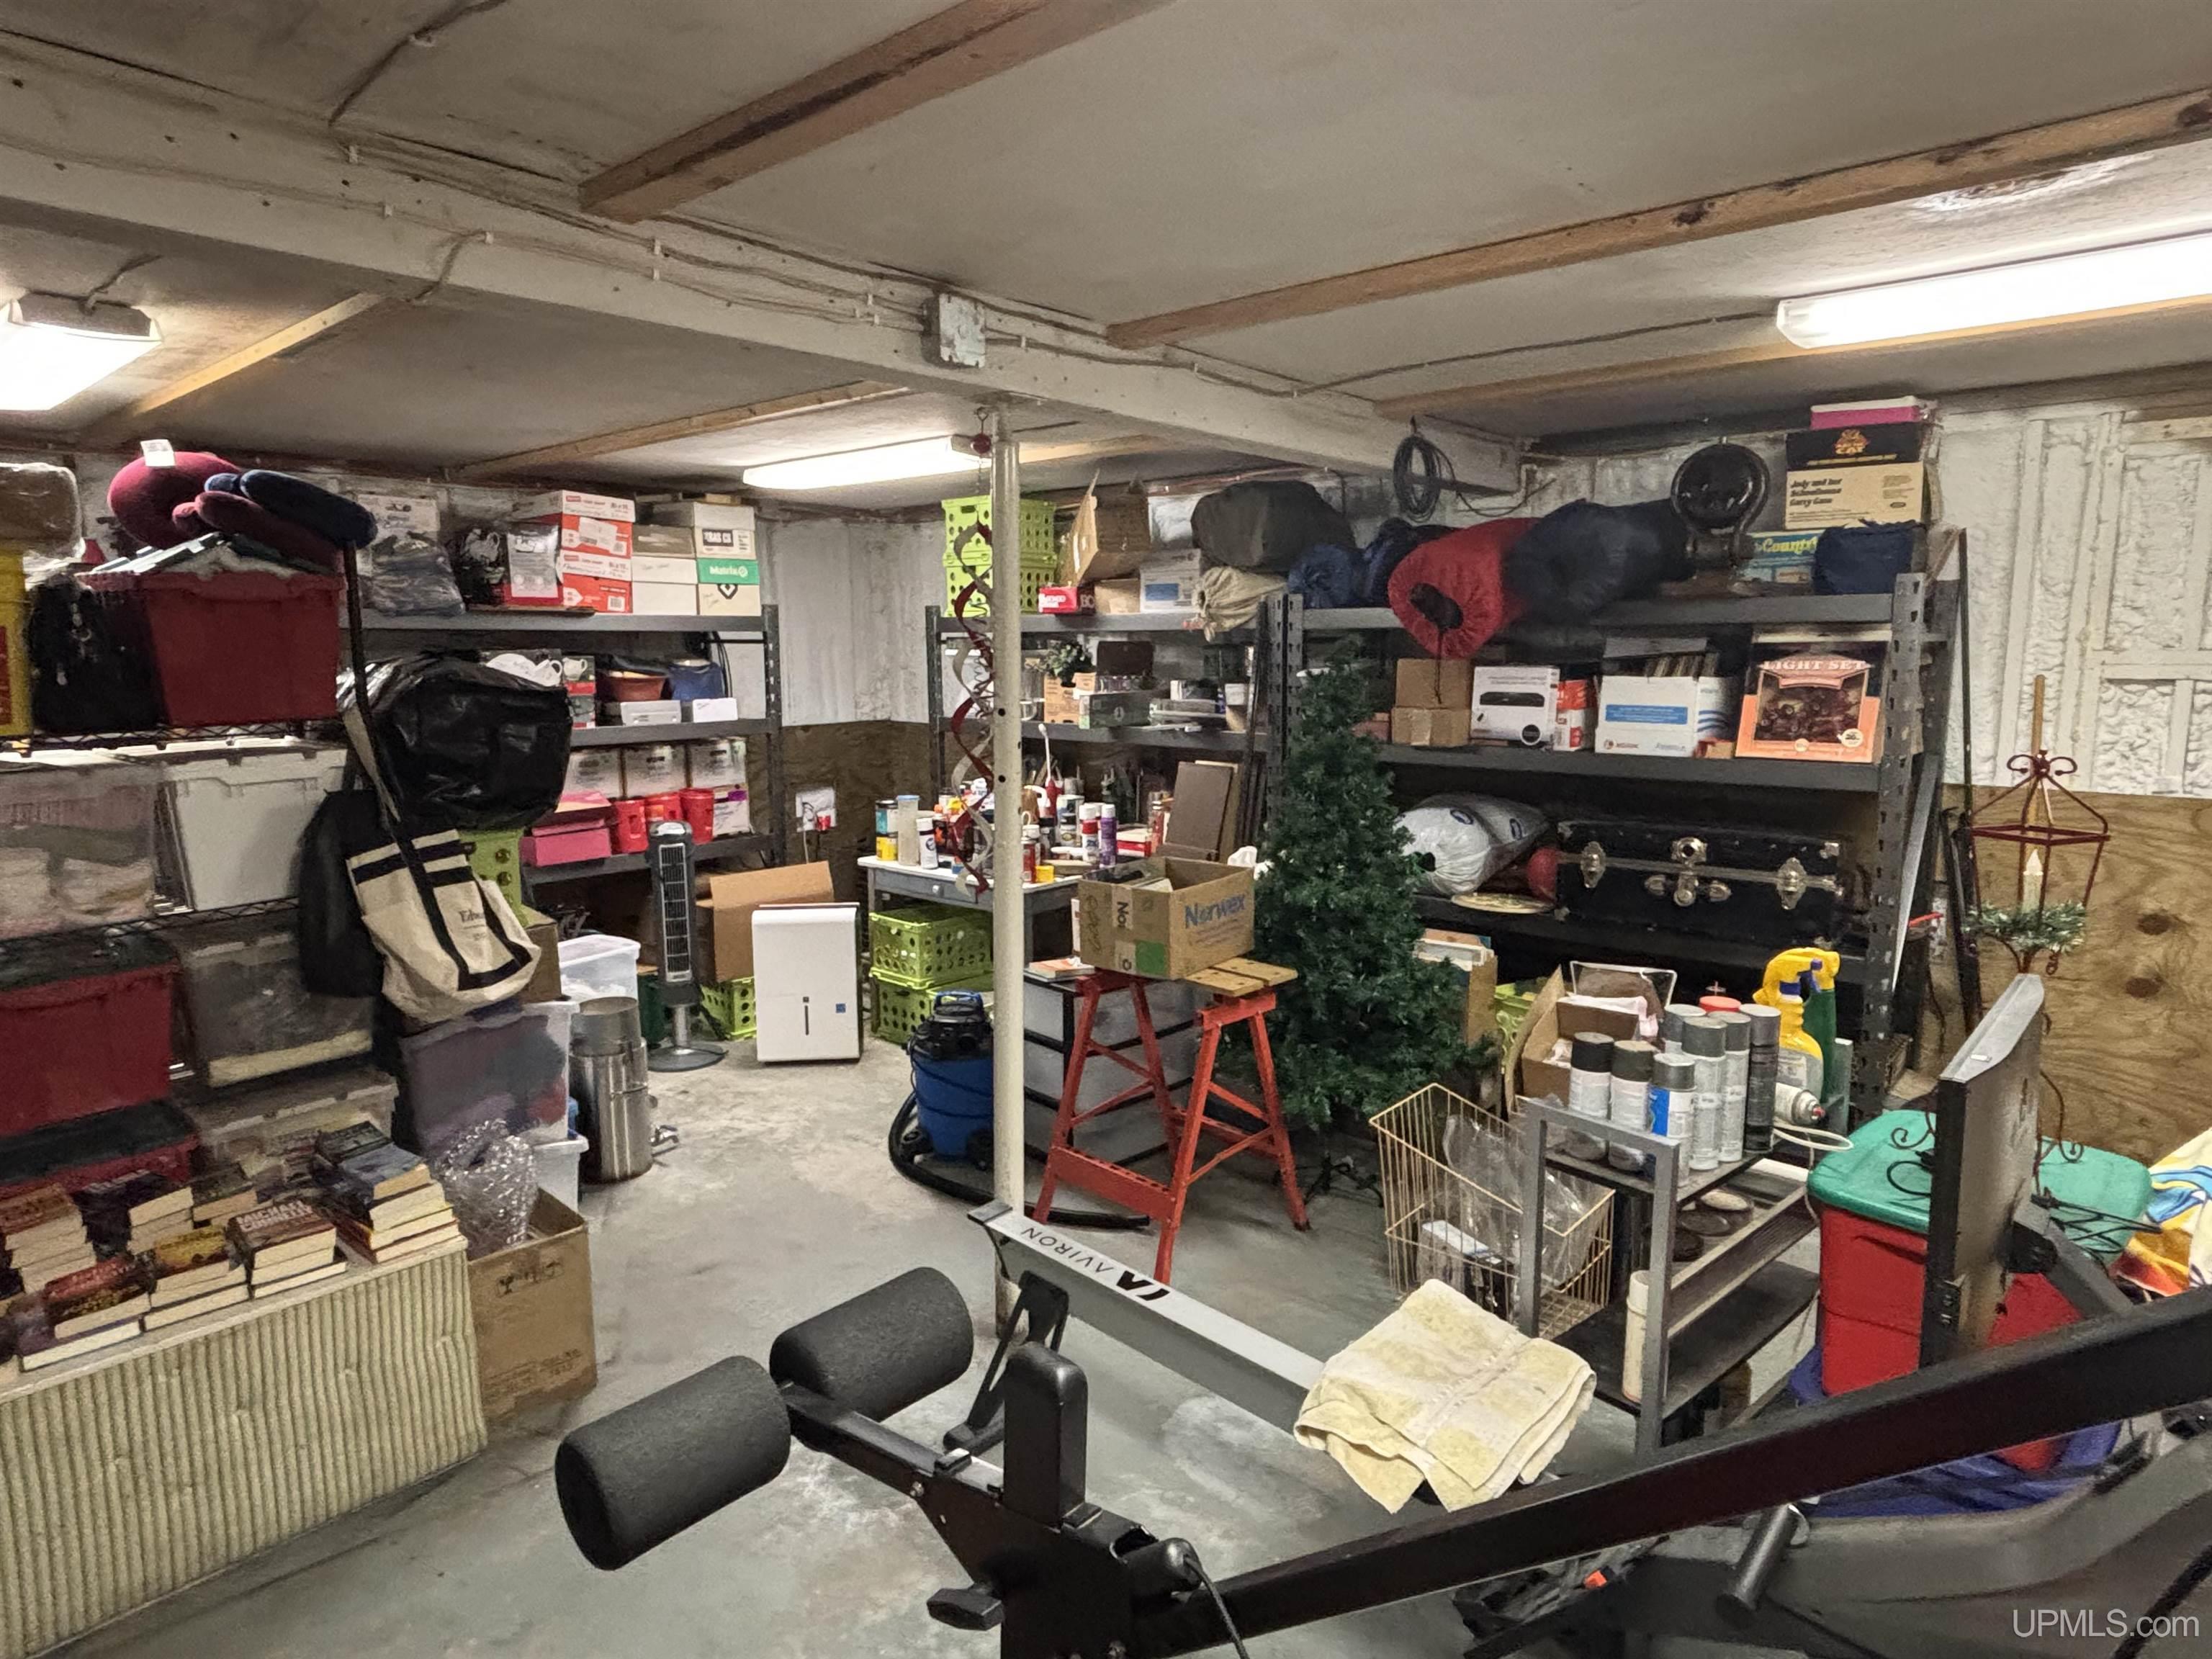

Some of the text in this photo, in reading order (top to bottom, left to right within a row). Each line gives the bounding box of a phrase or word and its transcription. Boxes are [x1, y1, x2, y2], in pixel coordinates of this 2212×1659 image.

[1765, 660, 1866, 670] LIGHT SET
[1184, 894, 1245, 929] Norwex
[236, 1200, 305, 1225] MICHAEL
[1020, 1227, 1115, 1273] AVIRON
